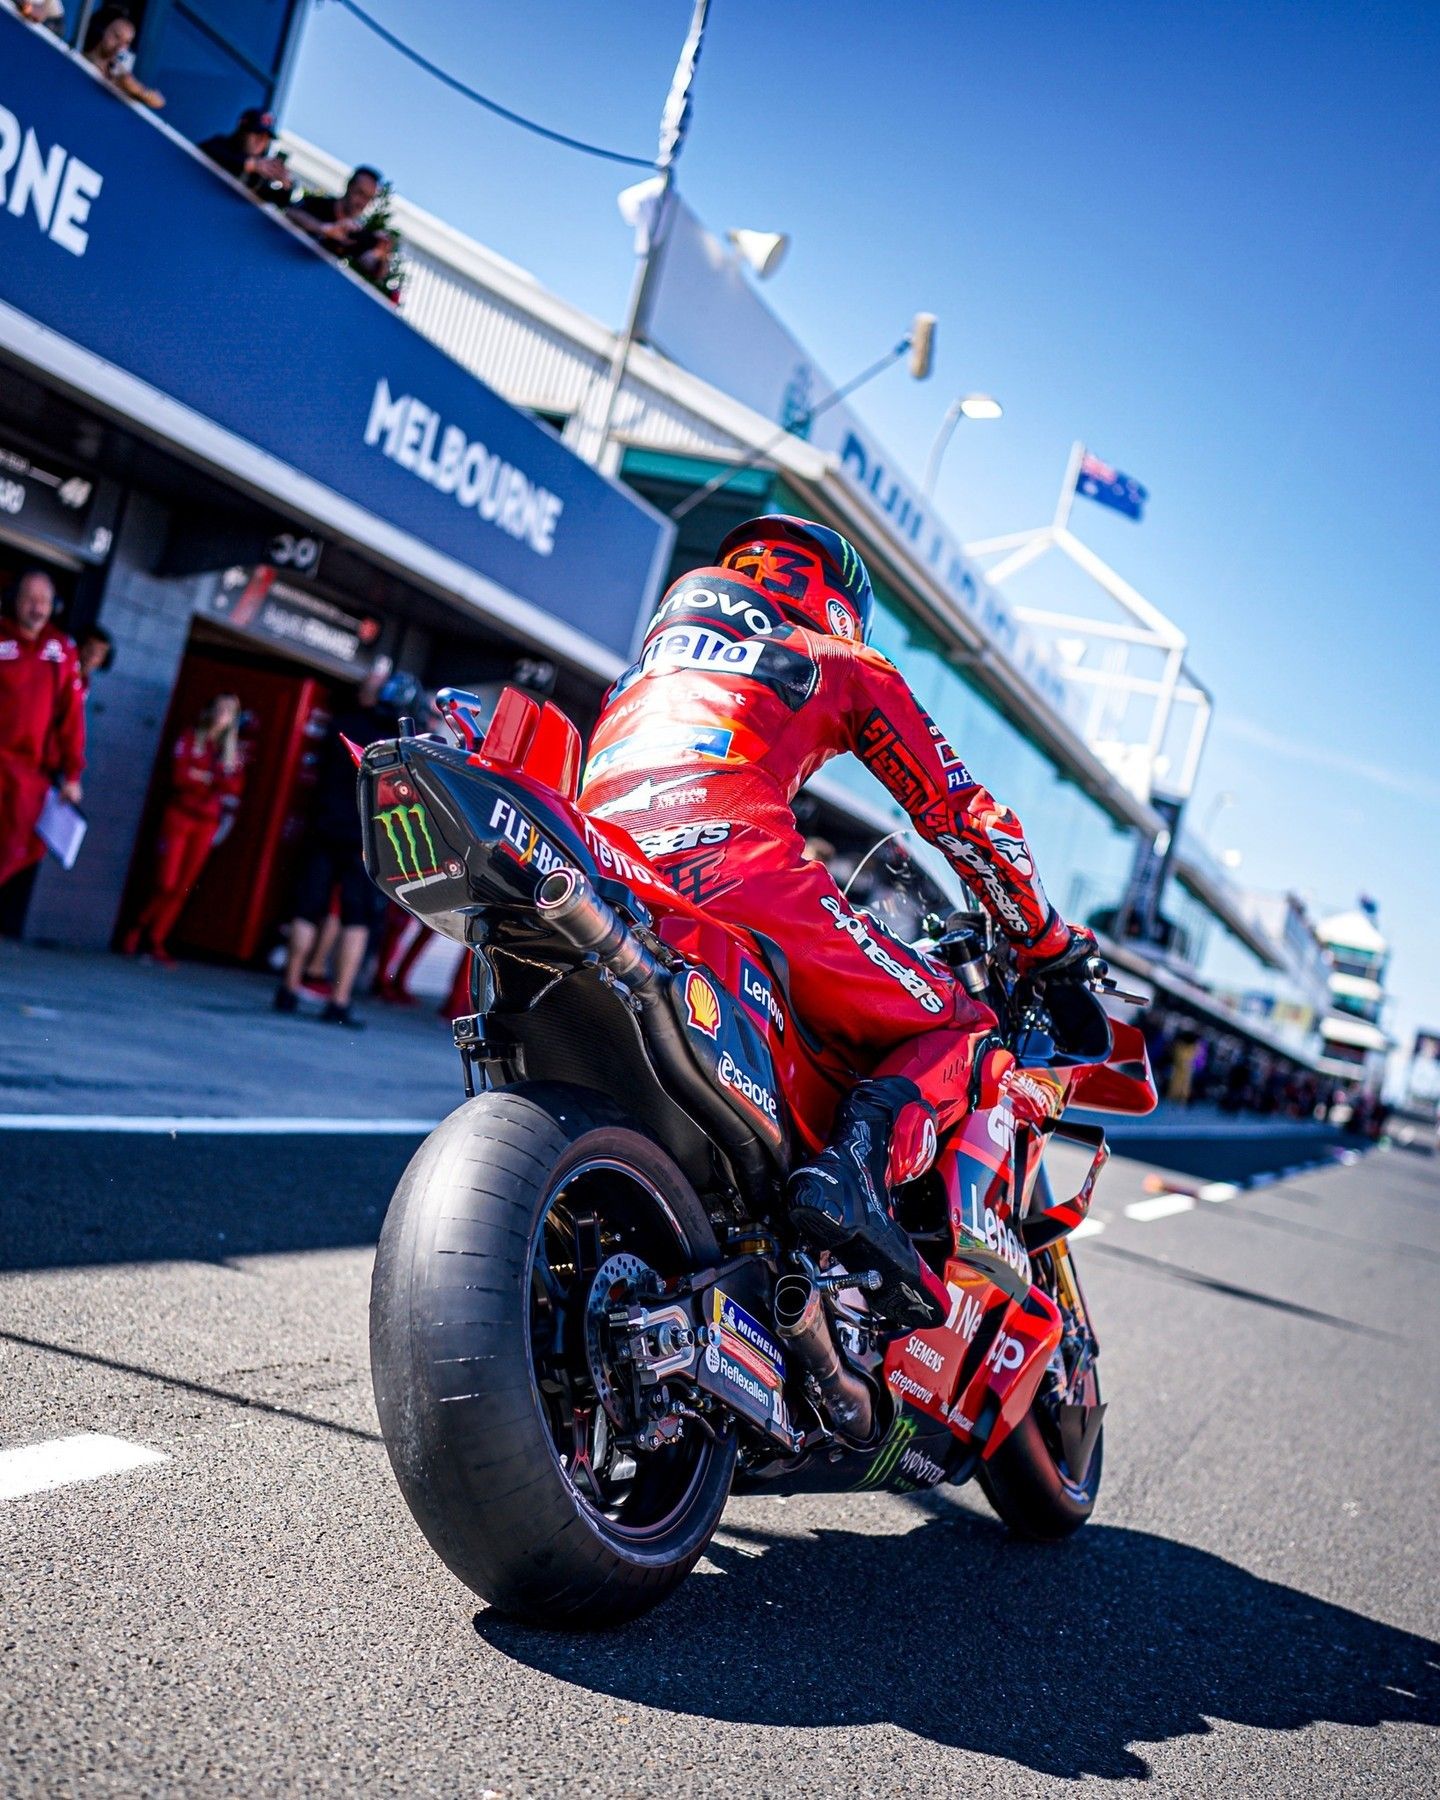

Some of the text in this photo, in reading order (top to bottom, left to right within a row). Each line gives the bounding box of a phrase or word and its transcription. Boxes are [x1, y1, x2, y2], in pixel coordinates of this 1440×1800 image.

[364, 377, 564, 557] MELBOURNE
[271, 534, 319, 569] 30
[643, 588, 773, 640] novo
[831, 602, 848, 639] SUOM
[638, 633, 748, 672] iello
[489, 798, 570, 875] FLEX-BO
[937, 834, 1029, 933] alpinestars
[820, 895, 944, 1014] alpinestars
[744, 968, 784, 1032] Lenovo
[737, 1319, 783, 1366] MICHELIN
[905, 1335, 945, 1373] SIEMENS
[720, 1356, 769, 1407] Reflexallen
[888, 1369, 934, 1405] streparava
[900, 1448, 945, 1487] MONSTER
